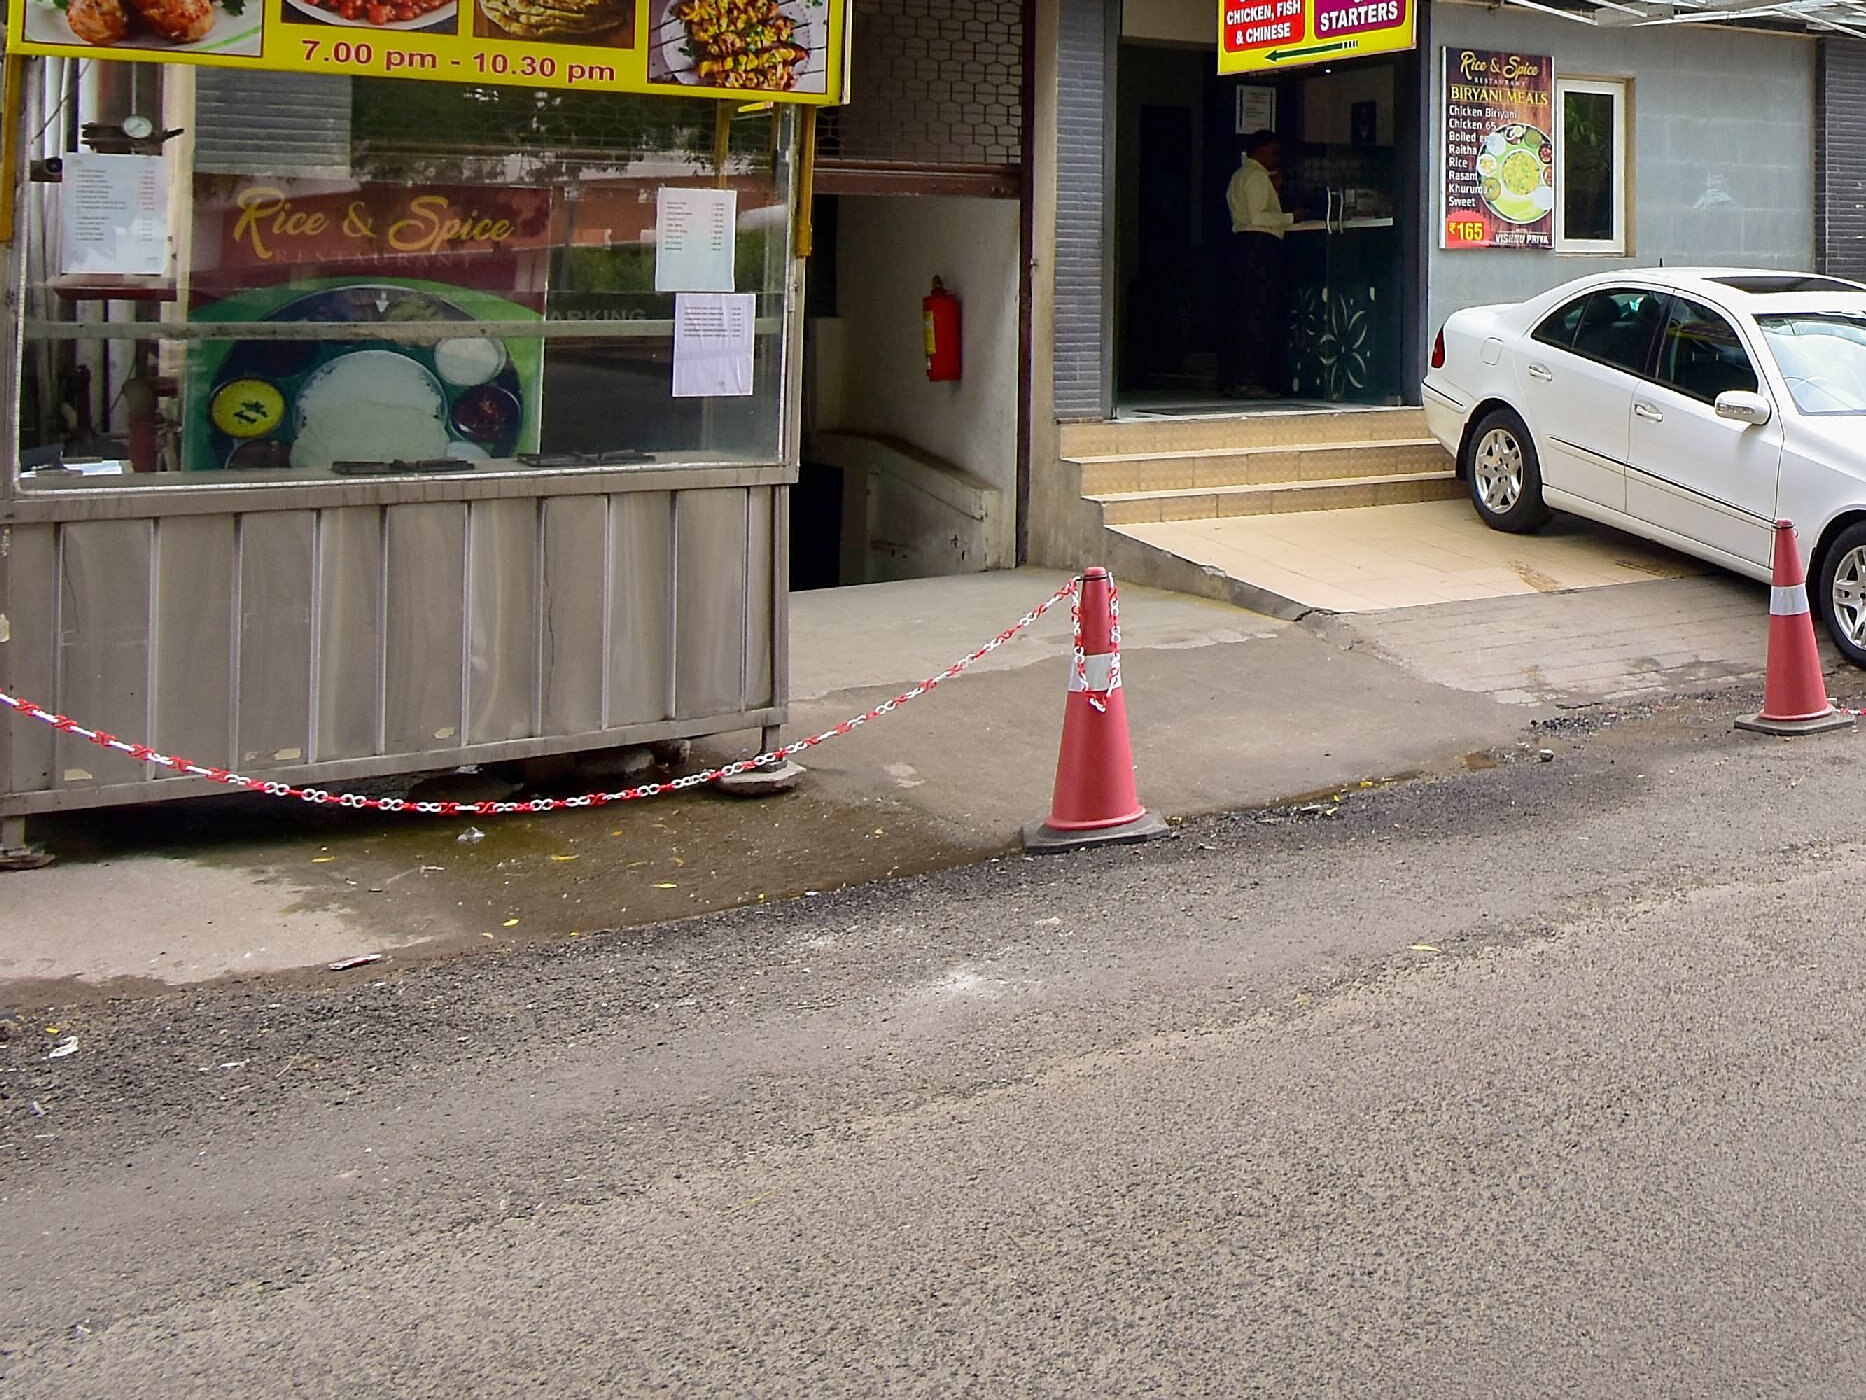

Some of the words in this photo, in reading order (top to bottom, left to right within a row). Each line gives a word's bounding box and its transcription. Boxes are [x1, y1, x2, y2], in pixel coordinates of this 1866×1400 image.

[1227, 4, 1275, 25] CHICKEN,
[1277, 0, 1301, 17] FISH
[1320, 1, 1398, 31] STARTERS
[1236, 30, 1243, 45] &
[1246, 23, 1291, 43] CHINESE
[301, 38, 373, 65] 7.00
[384, 46, 437, 73] pm
[473, 52, 557, 79] 10.30
[566, 60, 616, 84] pm
[1460, 51, 1487, 80] Rice
[1490, 58, 1500, 73] &
[1503, 55, 1539, 80] Spice
[1451, 86, 1502, 101] BIRYANI
[1508, 90, 1548, 105] MEALS
[1449, 105, 1482, 117] Chicken
[1485, 108, 1517, 119] Biriyani
[1449, 119, 1482, 129] Chicken
[1449, 131, 1476, 142] Boiled
[1449, 144, 1477, 155] Raitha
[1449, 157, 1468, 168] Rice
[1449, 171, 1477, 181] Rasam
[1449, 196, 1475, 207] Sweet
[233, 186, 329, 259] Rice
[343, 201, 376, 237] &
[388, 196, 514, 255] Spice
